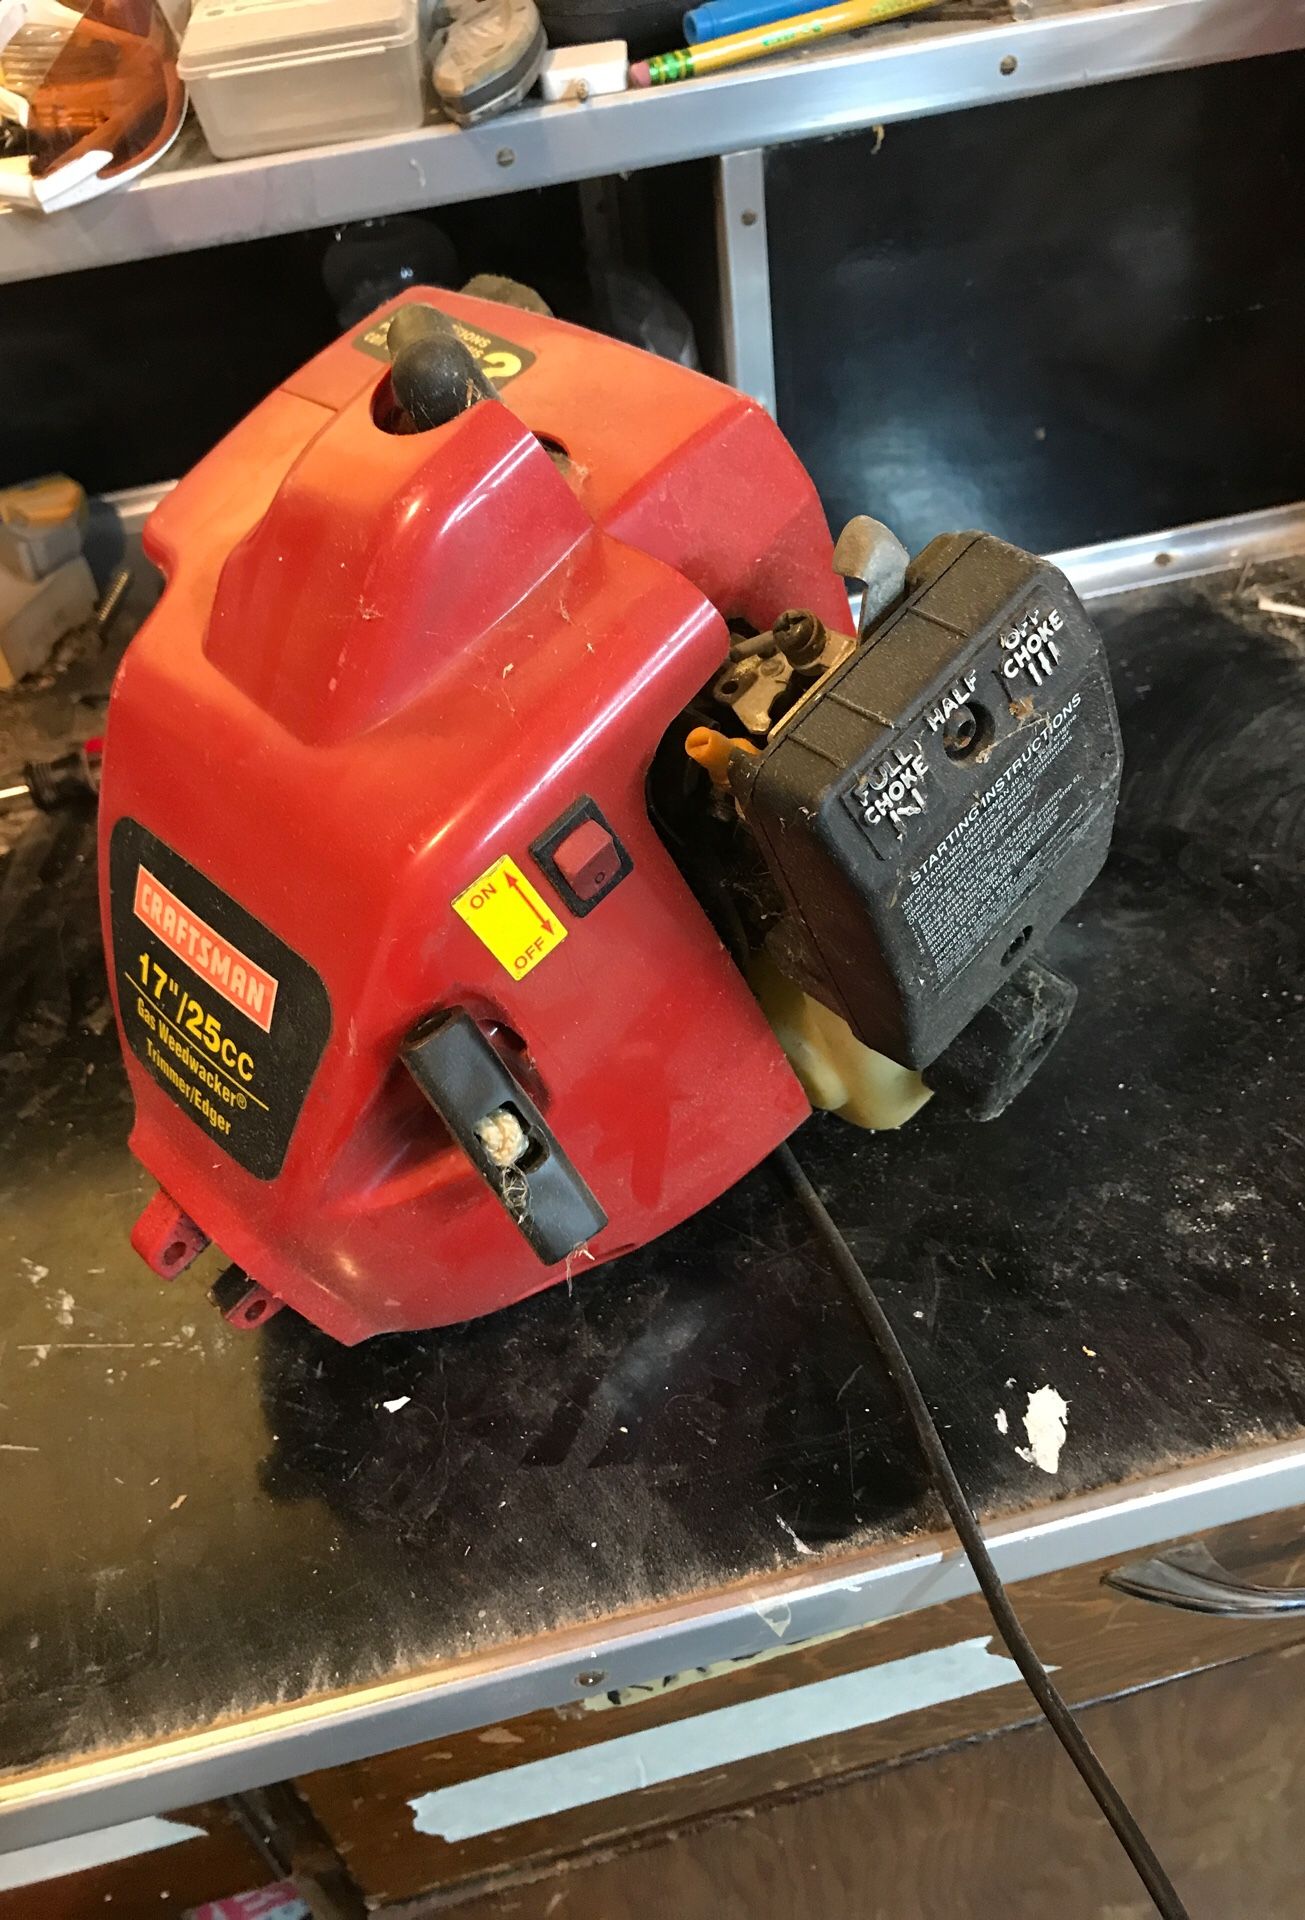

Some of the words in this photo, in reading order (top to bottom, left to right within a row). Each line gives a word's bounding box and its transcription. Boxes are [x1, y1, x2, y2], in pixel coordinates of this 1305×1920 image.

[1003, 608, 1064, 679] CHOKE
[926, 668, 977, 732] HALF
[863, 753, 929, 825] CHOKE
[910, 805, 978, 884] STARTING
[981, 693, 1080, 806] INSTRUCTIONS
[963, 788, 1009, 840] CRAFTSMAN
[908, 903, 927, 925] Other
[960, 843, 981, 868] cause
[982, 816, 1006, 843] engine
[914, 885, 929, 903] with
[931, 846, 963, 884] unleaded
[943, 848, 969, 879] manual
[982, 809, 1004, 837] proper
[469, 882, 498, 910] ON
[141, 882, 266, 1014] CRAFTSMAN
[514, 936, 546, 970] OFF
[137, 996, 157, 1031] Gas
[146, 1036, 232, 1136] Trimmer/Edger
